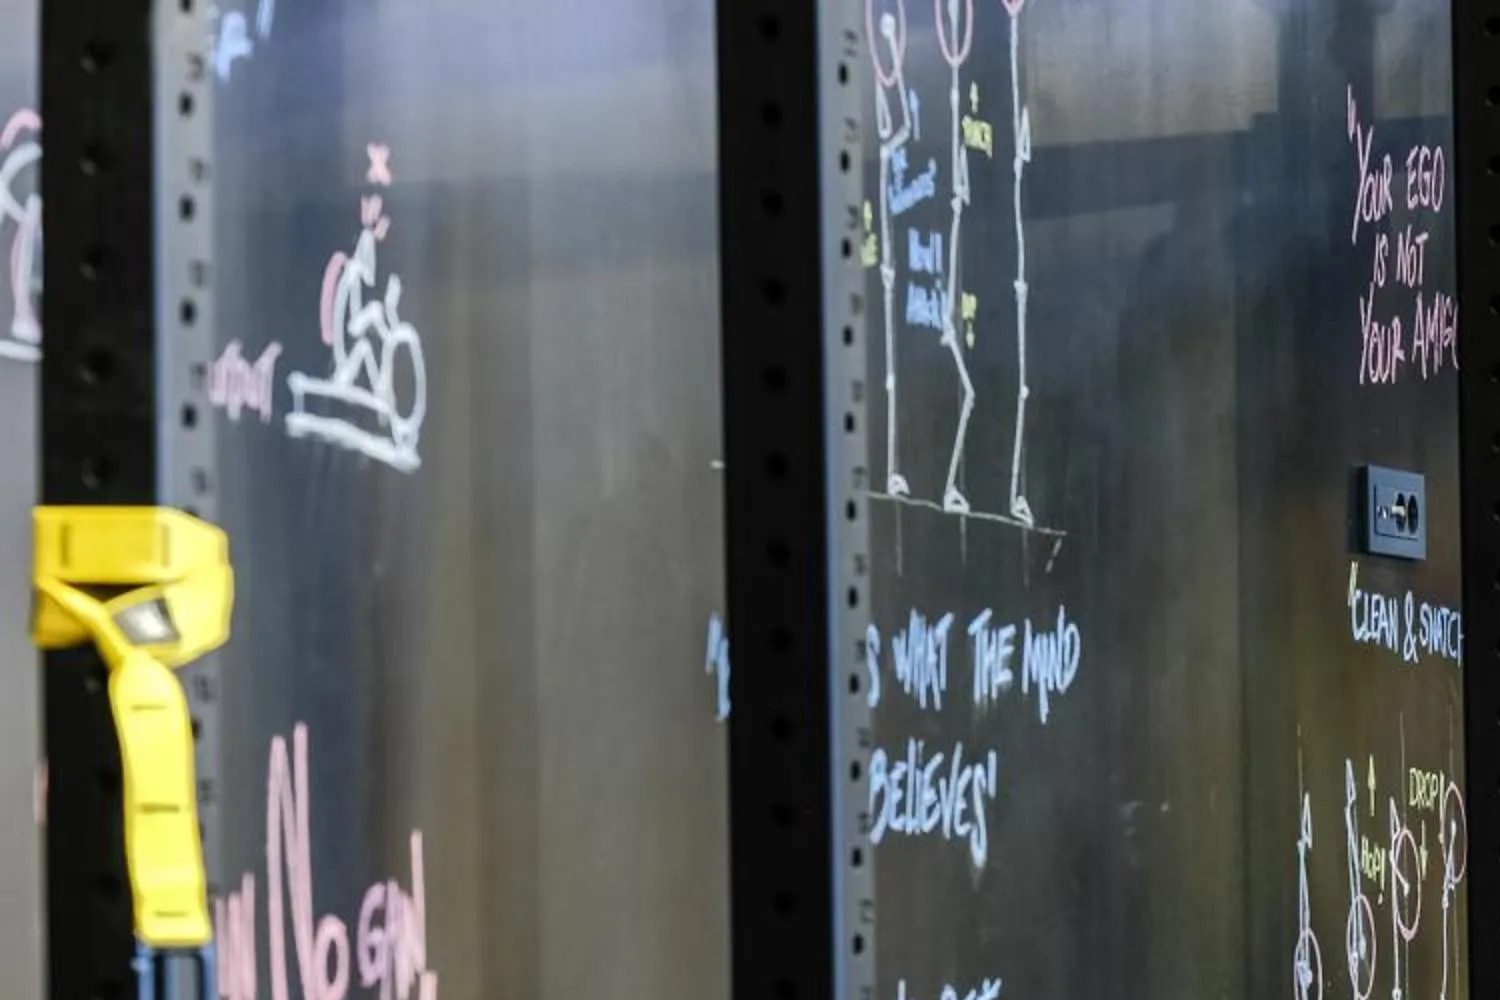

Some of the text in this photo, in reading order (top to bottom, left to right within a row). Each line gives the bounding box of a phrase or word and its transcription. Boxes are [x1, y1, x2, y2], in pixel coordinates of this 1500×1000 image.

[1406, 145, 1445, 213] EGO
[1373, 224, 1429, 288] IS NOT
[1403, 590, 1419, 664] &
[892, 608, 954, 711] WHAT
[968, 608, 1018, 704] THE
[1022, 604, 1081, 724] MIND
